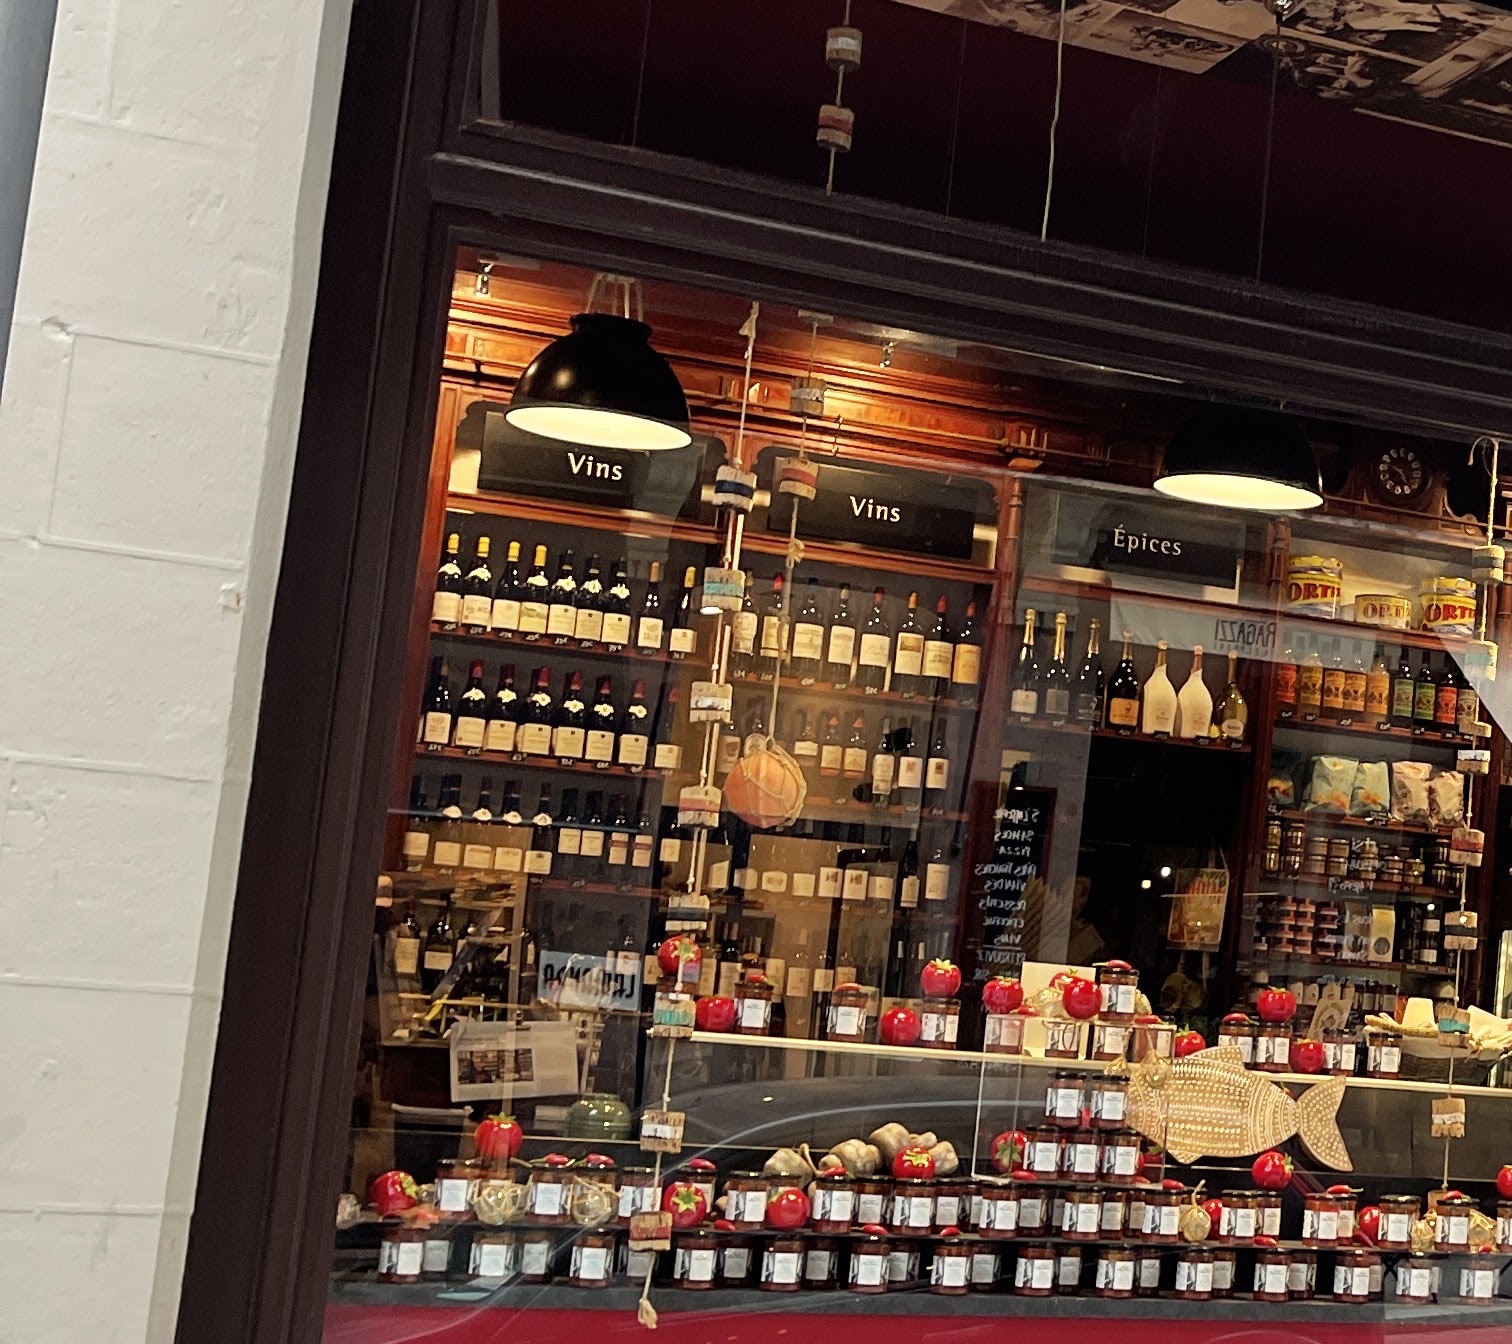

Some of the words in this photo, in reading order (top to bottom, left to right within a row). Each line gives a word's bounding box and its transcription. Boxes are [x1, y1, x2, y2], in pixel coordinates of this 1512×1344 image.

[568, 452, 624, 482] Vins
[849, 495, 902, 523] Vins
[1113, 524, 1182, 556] Épices
